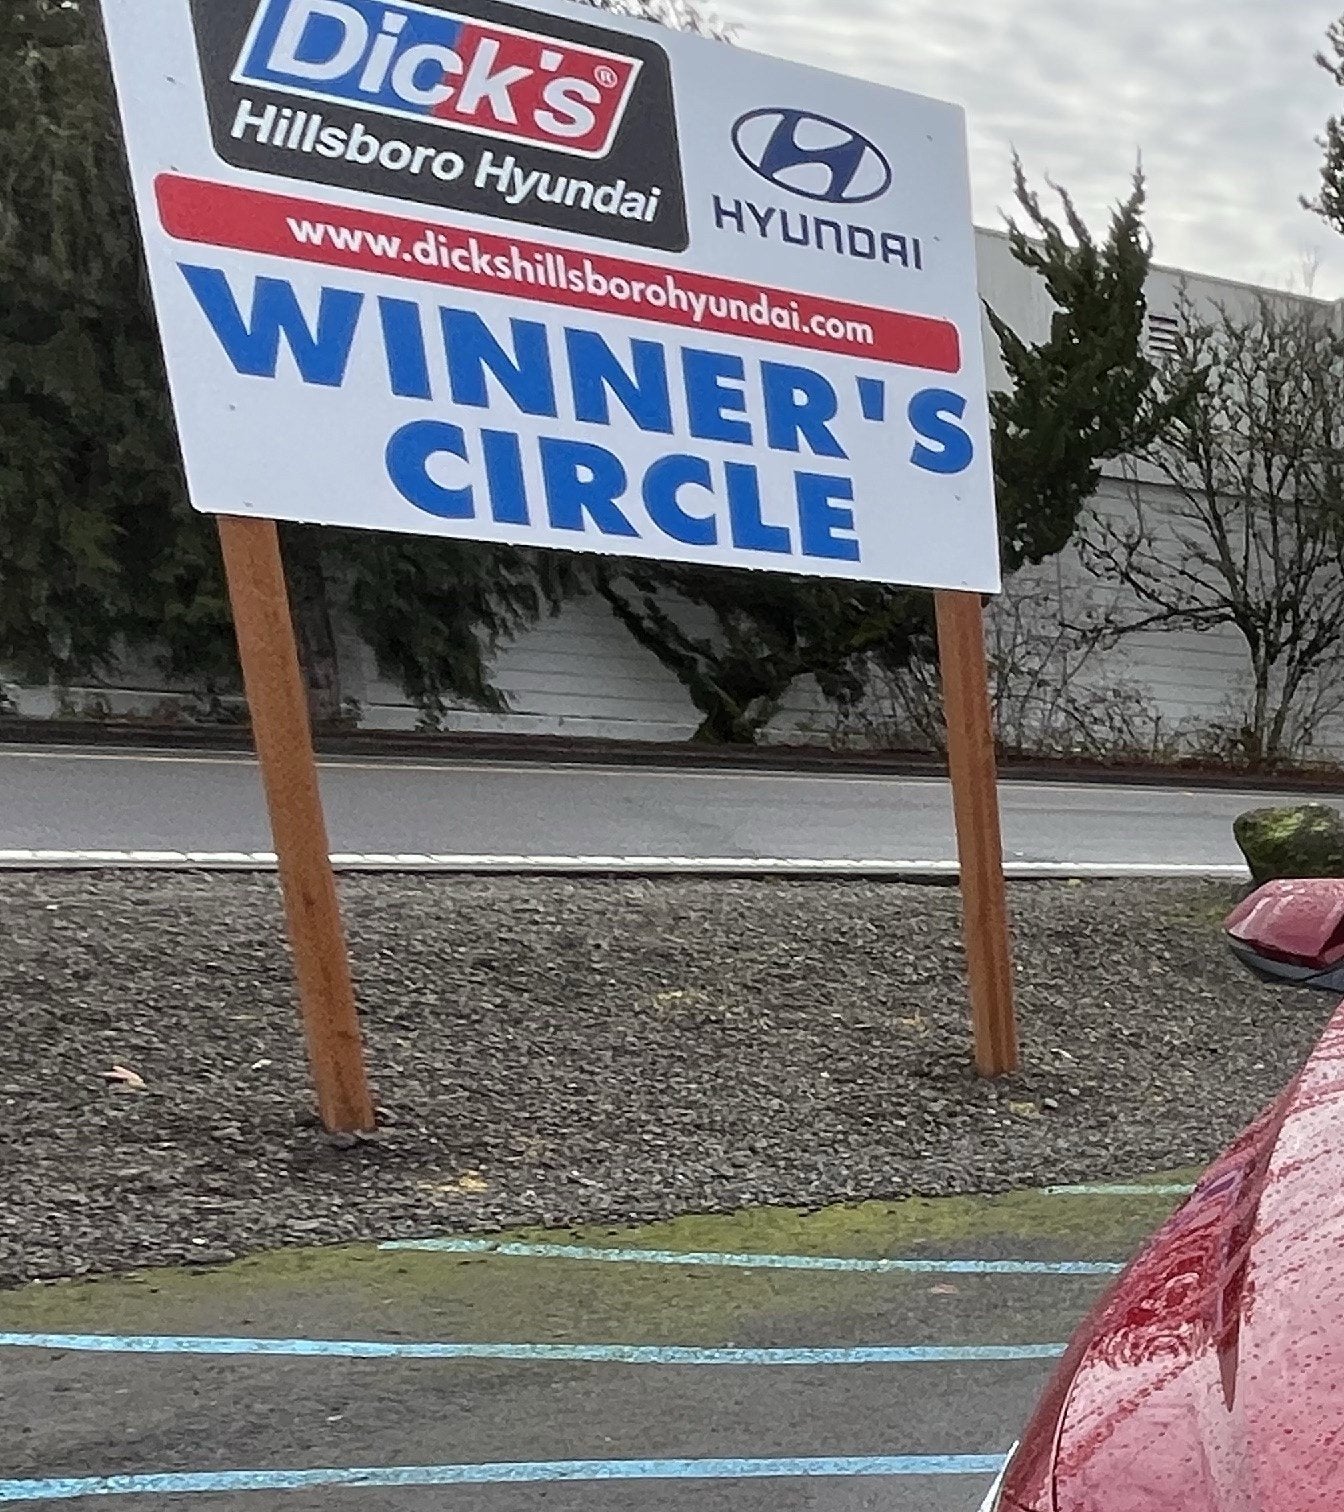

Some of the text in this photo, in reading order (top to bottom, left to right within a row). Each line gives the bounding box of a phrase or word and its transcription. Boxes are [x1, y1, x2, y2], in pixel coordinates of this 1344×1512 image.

[230, 99, 662, 223] Hillsboro Hyundai
[286, 213, 875, 346] www.dickshillsborohyundai.com
[713, 194, 923, 271] HYUNDAI
[177, 262, 975, 475] WINNER'S
[384, 420, 862, 562] CIRCLE
